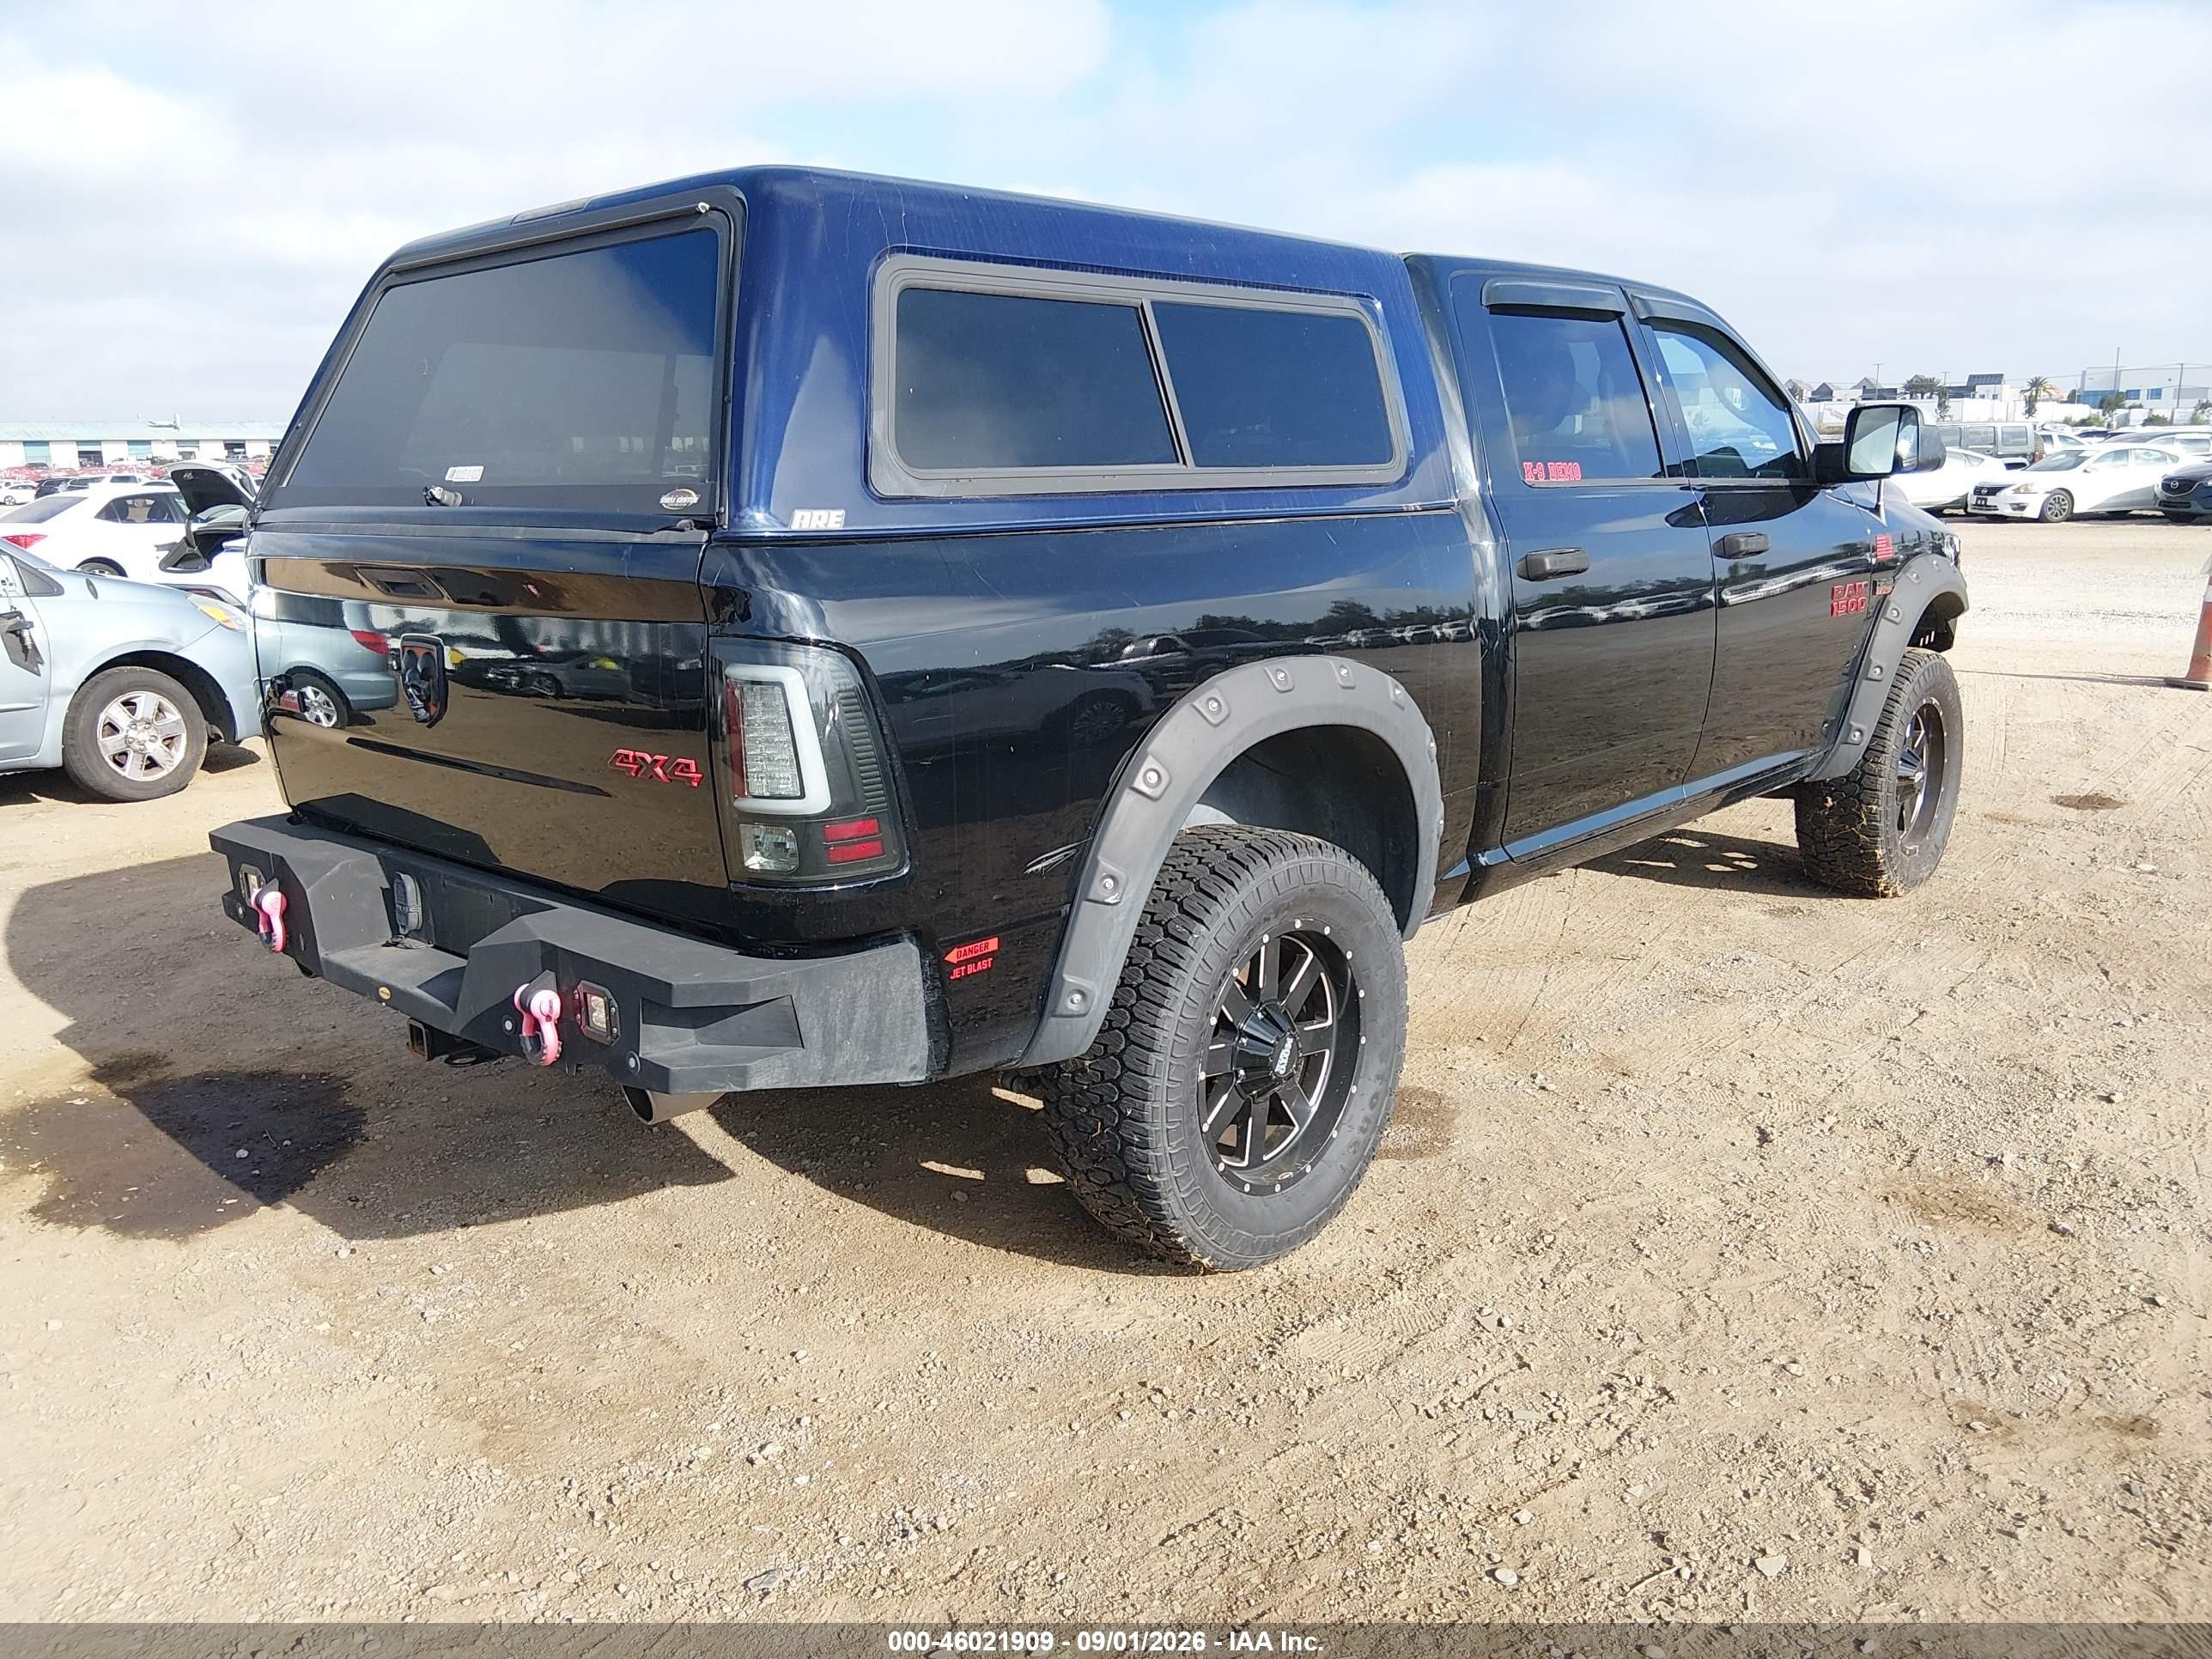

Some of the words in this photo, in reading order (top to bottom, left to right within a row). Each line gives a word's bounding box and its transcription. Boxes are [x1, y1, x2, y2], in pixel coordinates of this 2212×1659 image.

[1523, 462, 1545, 481] K-9
[1547, 462, 1581, 481] DEMO
[792, 510, 845, 531] ARE
[1831, 581, 1869, 600] RAM
[1830, 597, 1868, 617] 1500
[956, 941, 990, 959] DANGER
[950, 966, 966, 980] JET
[967, 957, 994, 975] BLAST
